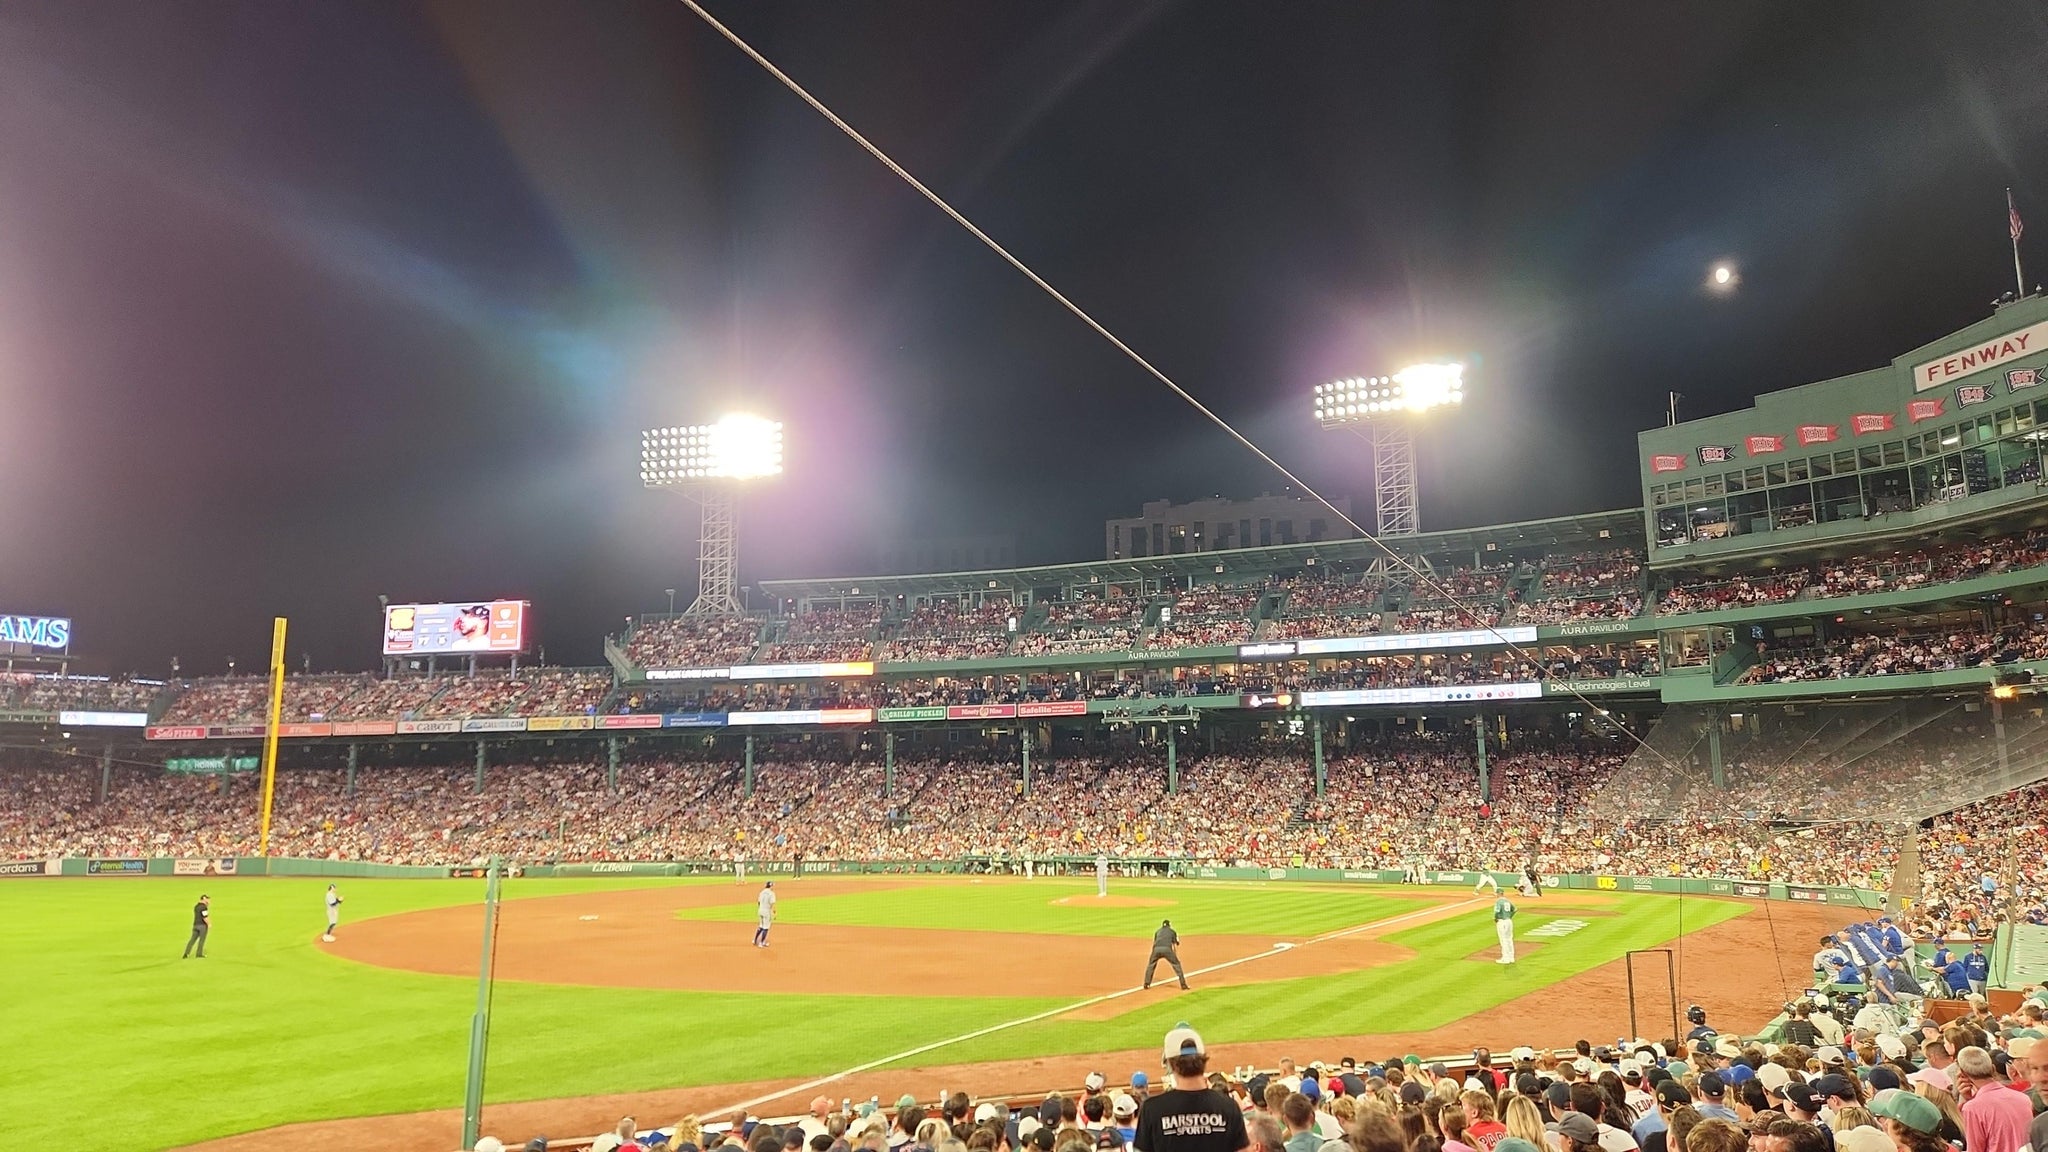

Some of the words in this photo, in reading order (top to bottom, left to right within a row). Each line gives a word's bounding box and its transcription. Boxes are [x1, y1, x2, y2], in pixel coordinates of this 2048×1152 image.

[1927, 333, 2030, 382] FENWAY
[1858, 417, 1883, 428] 1916
[1590, 623, 1629, 633] PAVILION
[1150, 650, 1180, 659] PAVILION
[1628, 679, 1651, 689] Level
[917, 709, 944, 717] PICKLES
[961, 708, 979, 716] Ninety
[989, 707, 1003, 715] Nine
[174, 729, 198, 738] PIZZA
[1161, 1113, 1227, 1131] BARSTOOL
[1176, 1125, 1212, 1136] SPORTS
